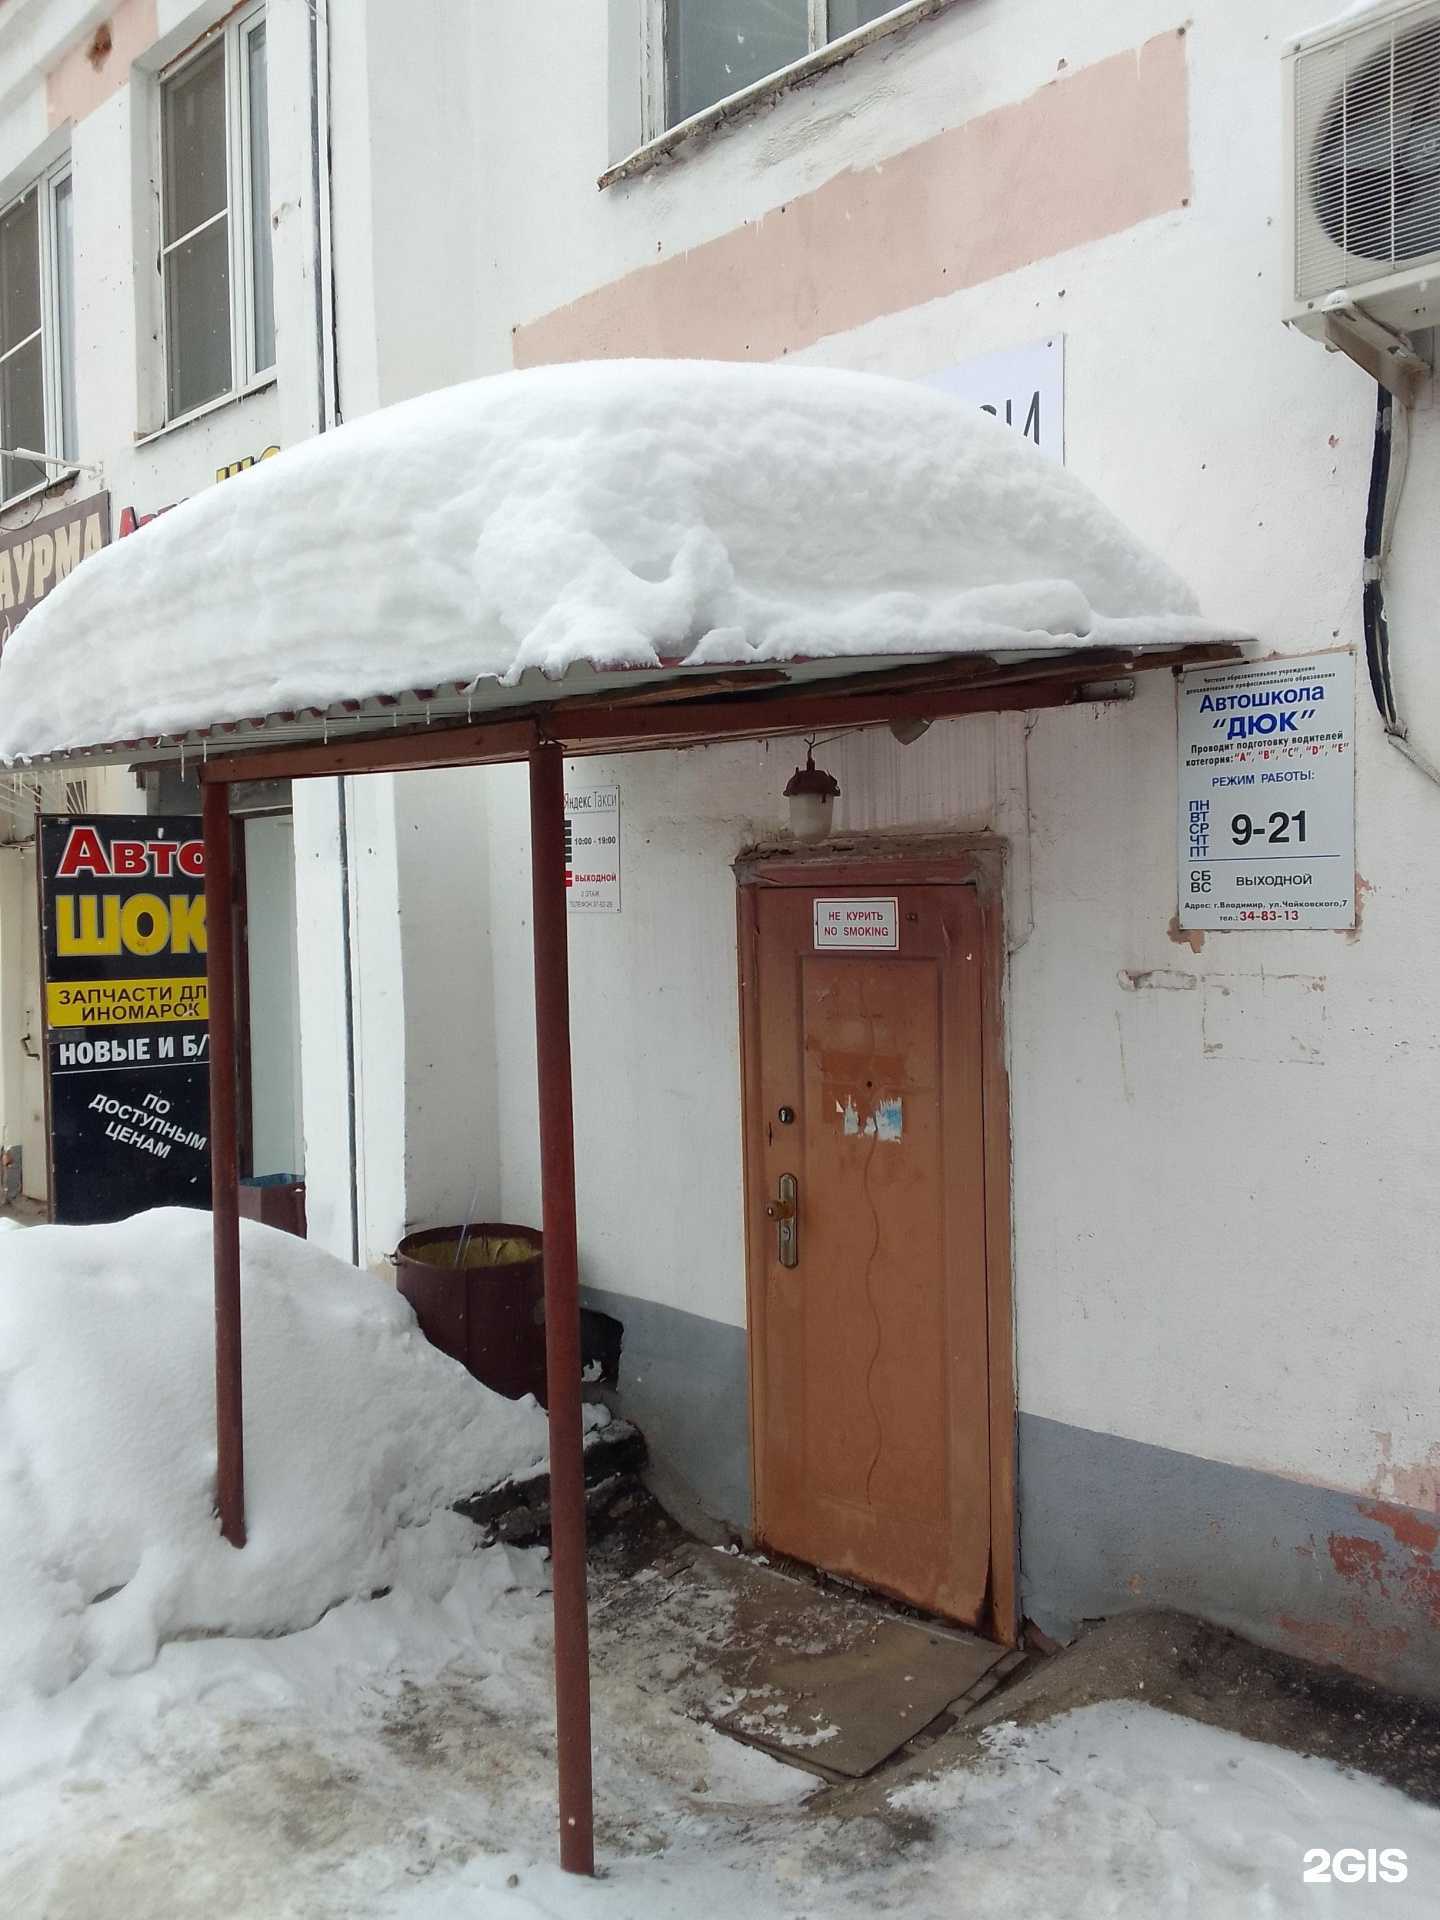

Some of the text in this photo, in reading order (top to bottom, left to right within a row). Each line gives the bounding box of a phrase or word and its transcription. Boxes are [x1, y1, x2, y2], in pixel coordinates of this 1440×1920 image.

[1200, 685, 1324, 713] Автошкола
[1191, 731, 1343, 755] Проводит подготовку водителей
[1212, 770, 1315, 787] РЕЖИМ РАБОТЫ:
[593, 791, 617, 808] Такси
[1189, 800, 1209, 811] ПН
[1190, 811, 1208, 822] ВТ
[1189, 823, 1209, 834] СР
[1231, 810, 1306, 845] 9-21
[575, 837, 592, 845] 10:00
[598, 836, 616, 845] 19:00
[1190, 834, 1209, 846] ЧТ
[1190, 846, 1208, 857] ПТ
[575, 874, 616, 883] ВЫХОДНОЙ
[1190, 870, 1211, 881] СБ
[1236, 873, 1312, 887] ВЫХОДНОЙ
[1190, 882, 1212, 893] ВС
[1184, 902, 1210, 910] Адрес:
[828, 911, 883, 921] НЕ КУРИТЬ
[1240, 910, 1299, 921] 34-83-13
[56, 893, 208, 957] ШОК
[824, 927, 888, 937] NO SMOKING
[59, 985, 207, 1005] ЗАПЧАСТИ ДЛ
[82, 1003, 200, 1021] ИНОМАРОК
[60, 1034, 209, 1065] НОВЫЕ И Б/
[142, 1093, 171, 1114] ПО
[88, 1094, 207, 1150] ДОСТУПНЫМ
[105, 1121, 171, 1158] ЦЕНАМ
